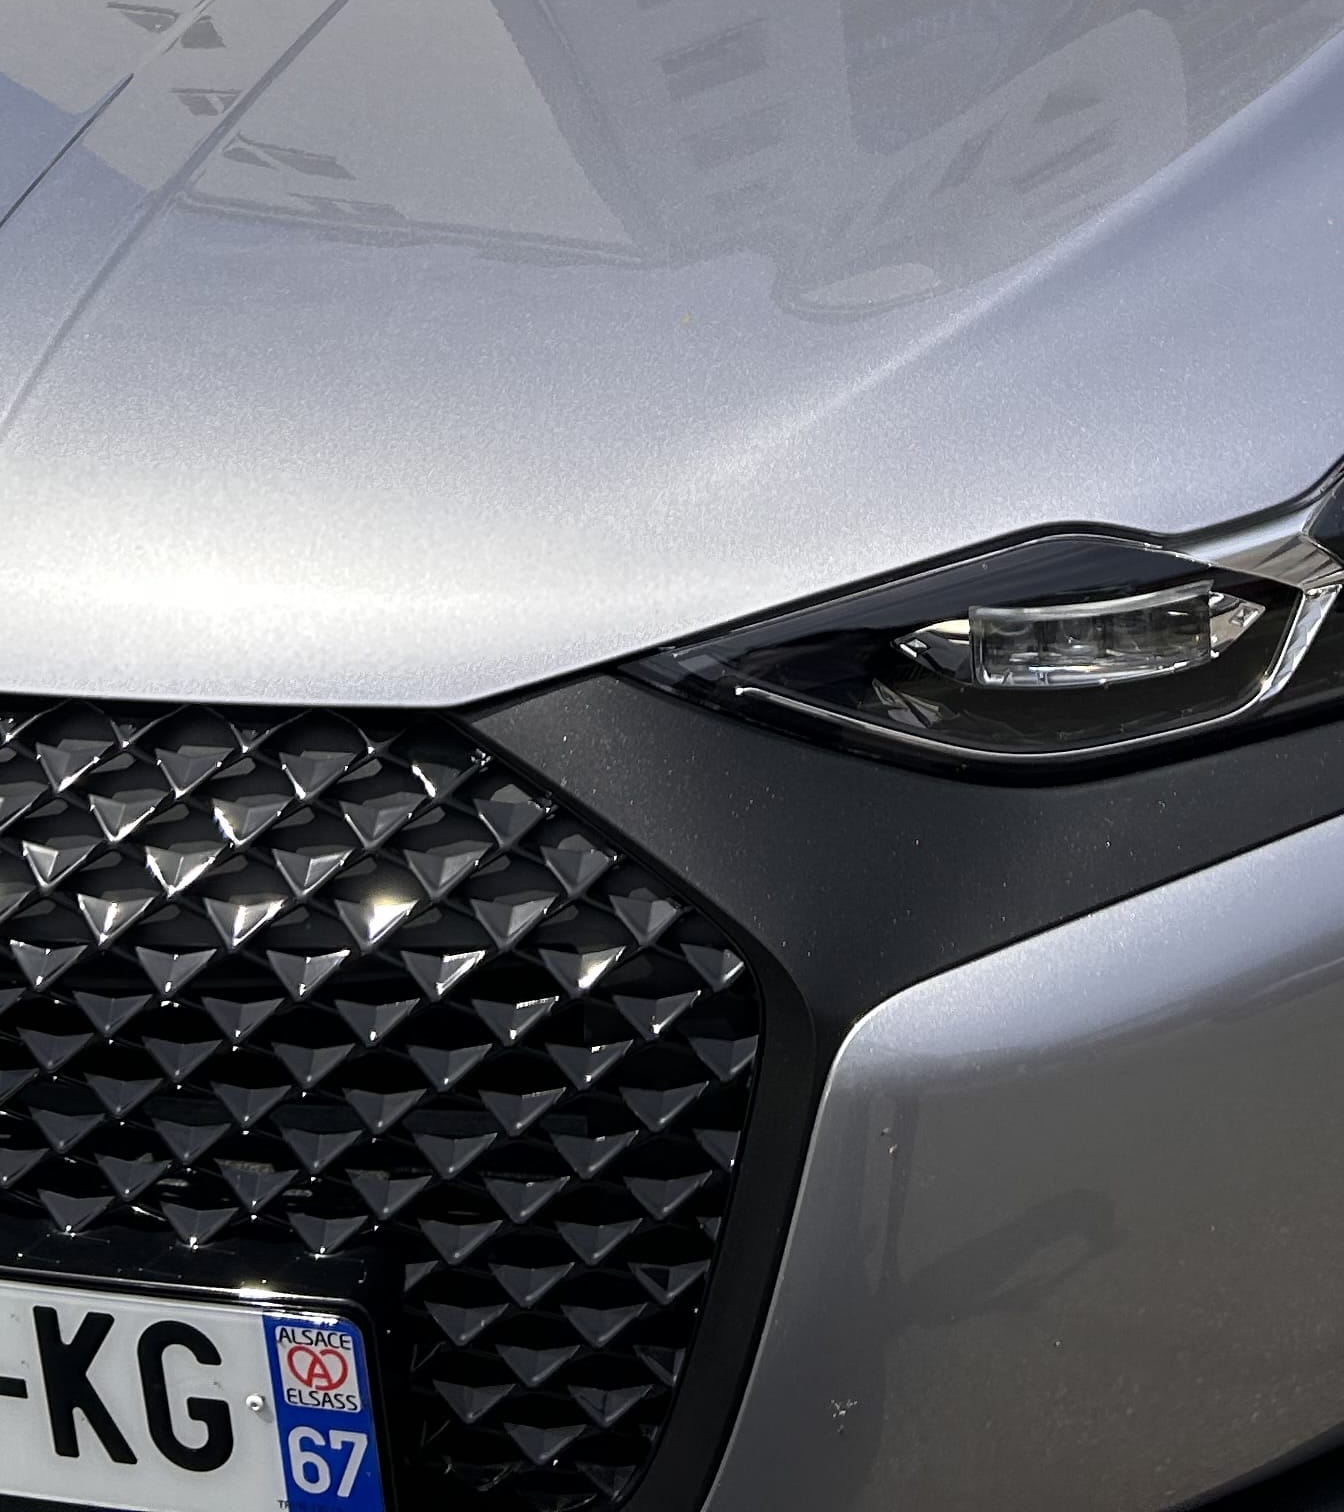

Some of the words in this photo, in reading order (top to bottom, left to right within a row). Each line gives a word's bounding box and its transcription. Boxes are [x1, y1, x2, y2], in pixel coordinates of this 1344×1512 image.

[278, 1327, 352, 1350] ALSACE
[286, 1388, 358, 1410] ELSASS
[287, 1426, 368, 1498] 67
